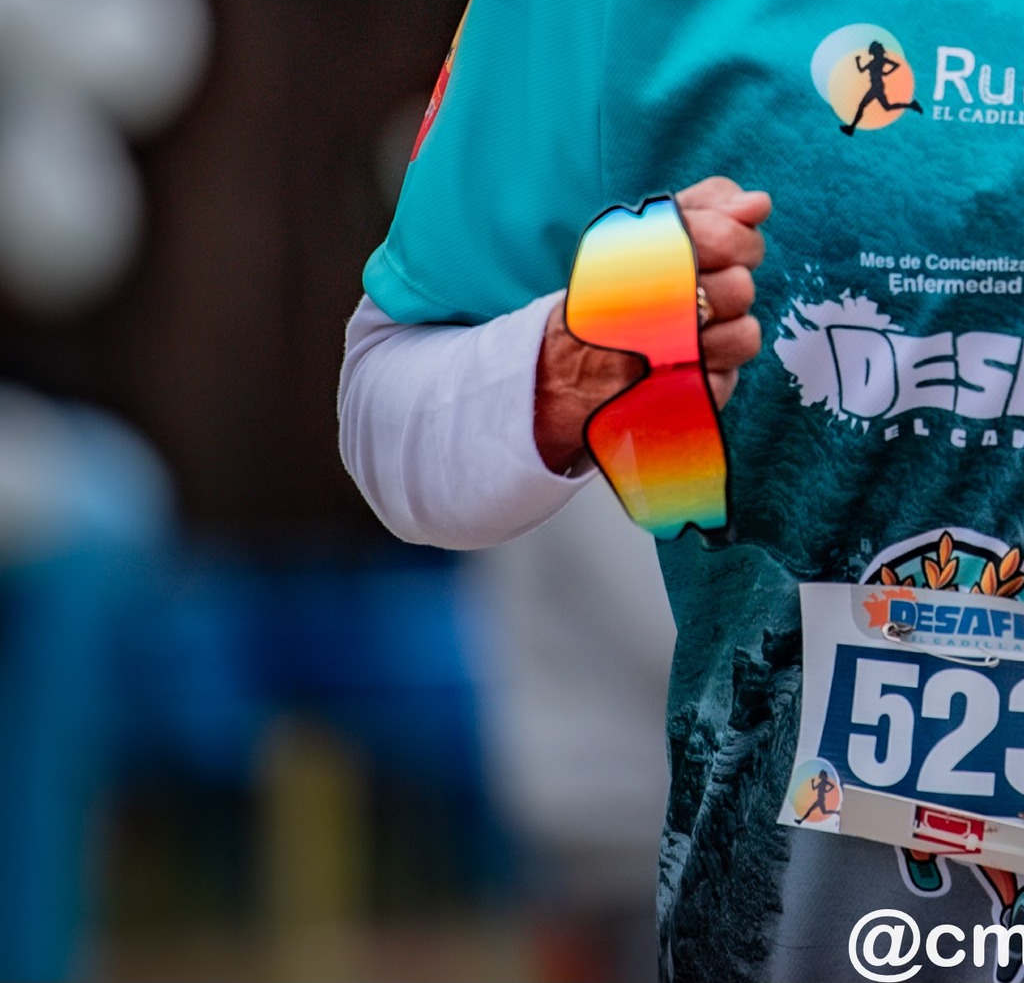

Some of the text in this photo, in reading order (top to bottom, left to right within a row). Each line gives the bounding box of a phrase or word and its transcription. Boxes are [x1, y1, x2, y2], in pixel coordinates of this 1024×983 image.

[932, 106, 954, 121] EL
[859, 251, 895, 269] Mes
[899, 254, 921, 270] de
[888, 273, 1023, 296] Enfermedad
[884, 418, 930, 441] EL
